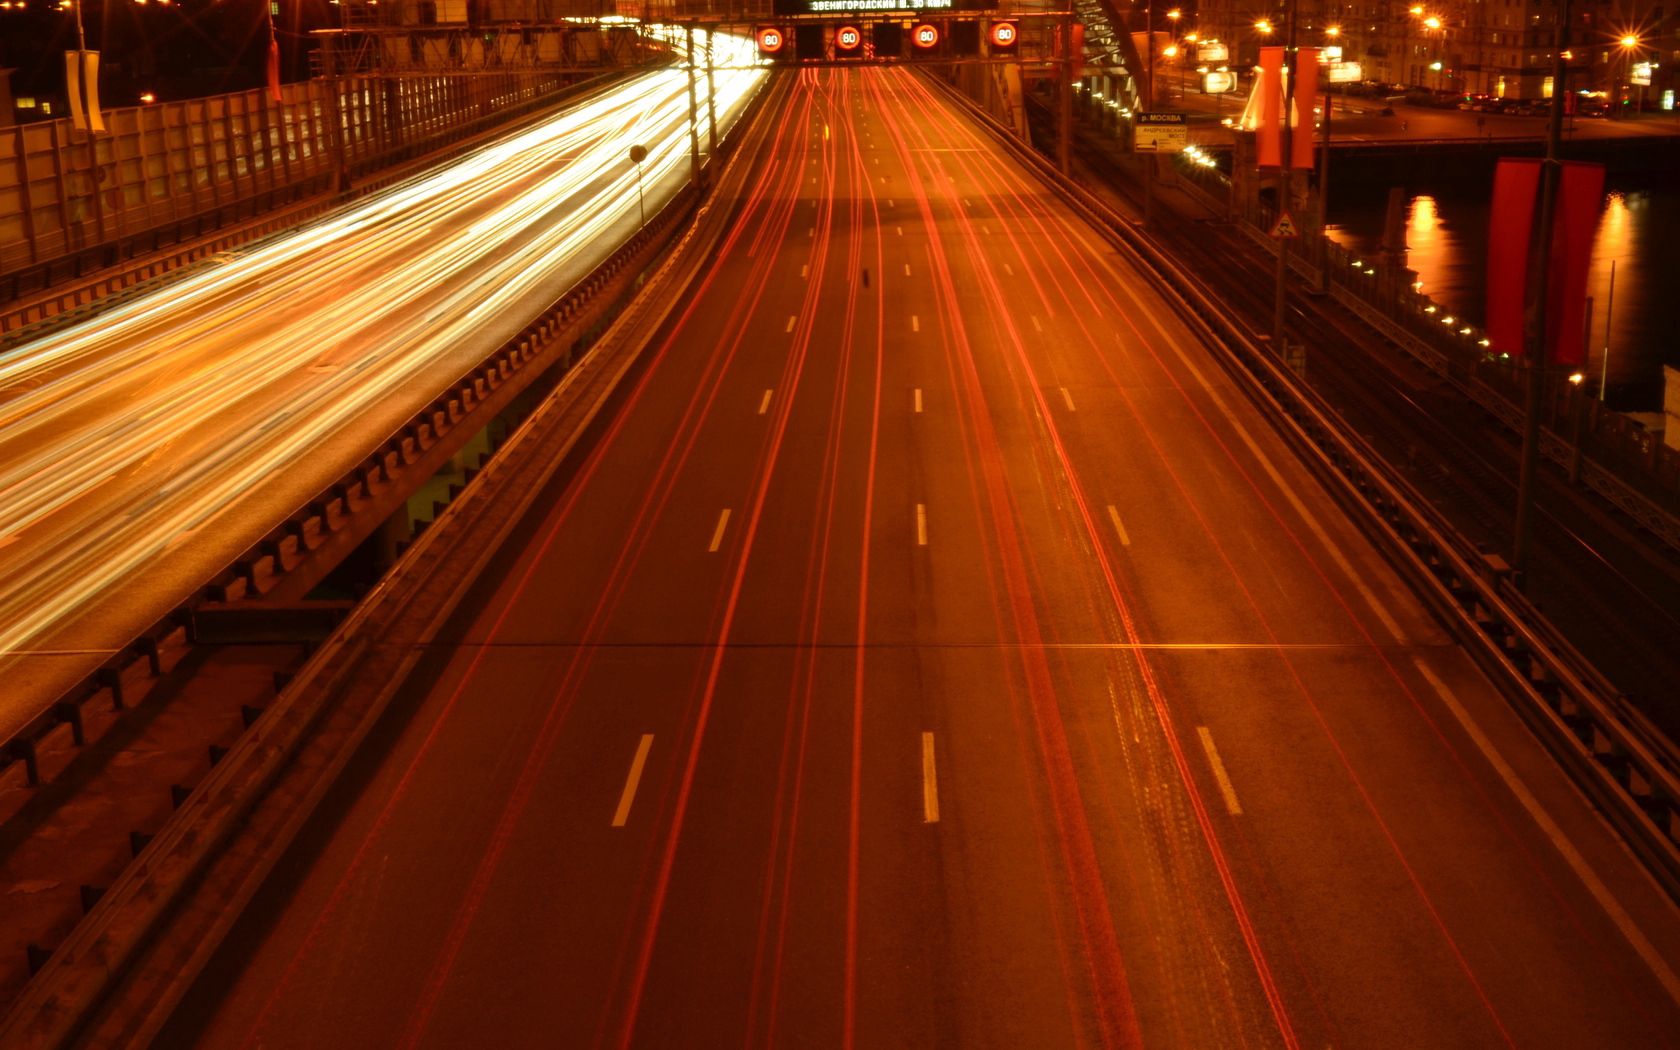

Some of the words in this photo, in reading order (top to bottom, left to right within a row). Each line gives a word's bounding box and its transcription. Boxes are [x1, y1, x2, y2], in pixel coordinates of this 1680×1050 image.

[842, 32, 856, 43] 80
[920, 31, 934, 41] 80
[998, 29, 1012, 39] 80
[764, 34, 778, 45] 80
